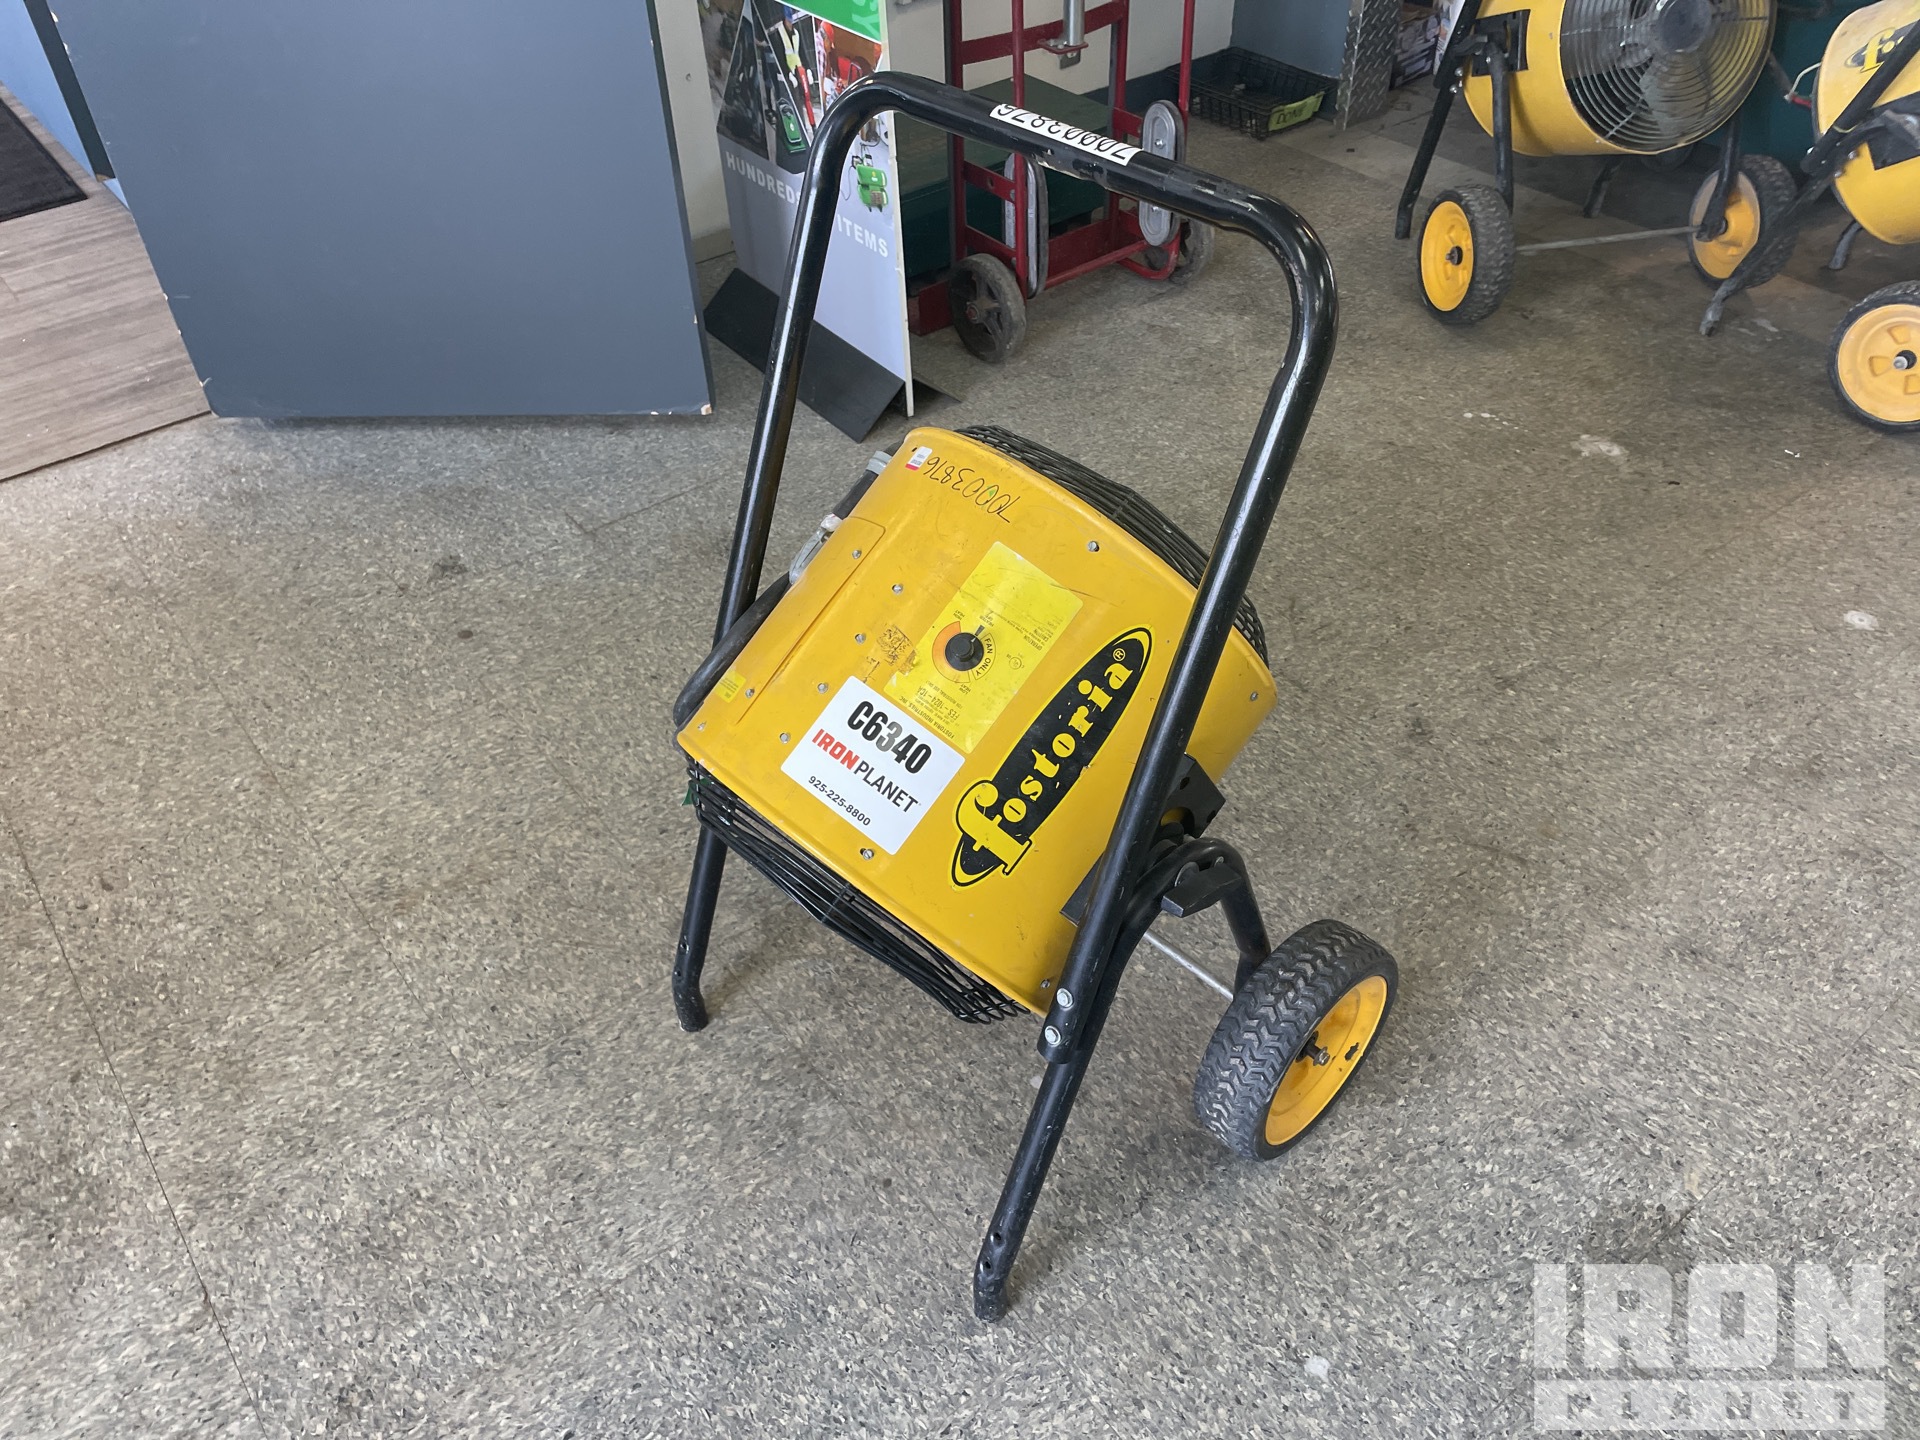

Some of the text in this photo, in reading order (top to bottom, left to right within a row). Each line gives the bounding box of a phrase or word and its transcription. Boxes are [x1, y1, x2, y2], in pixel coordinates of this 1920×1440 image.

[836, 213, 889, 258] ITEMS
[922, 456, 1020, 524] 70003876
[975, 658, 992, 677] ONLY
[931, 696, 945, 709] 1024
[947, 708, 960, 721] FES
[847, 700, 932, 774] C6340
[933, 720, 955, 739] FOSTORIA
[808, 775, 871, 826] 925-225-8800
